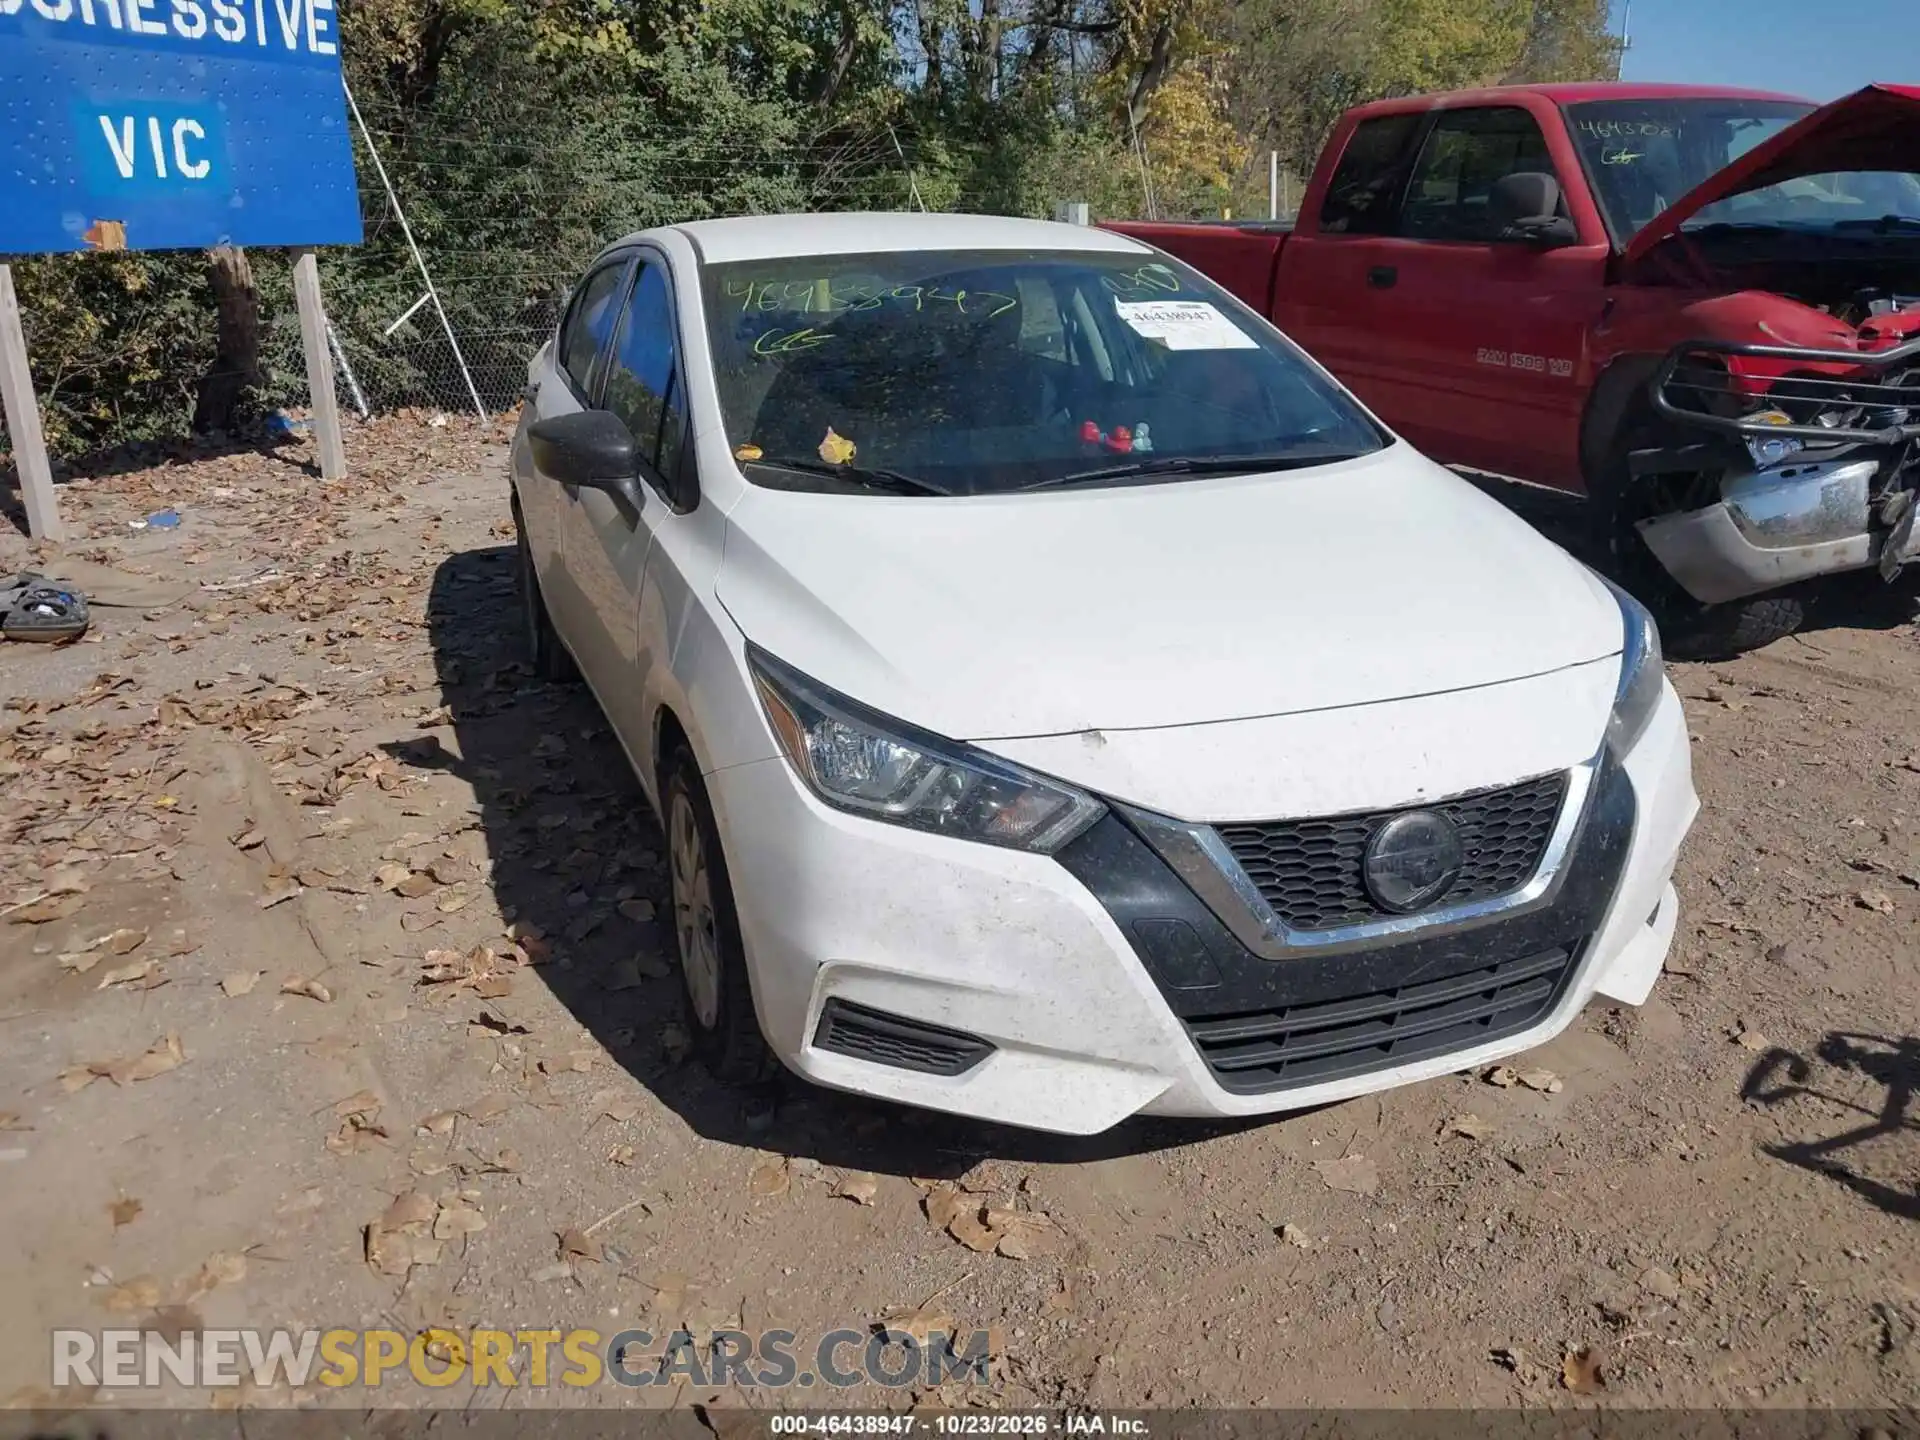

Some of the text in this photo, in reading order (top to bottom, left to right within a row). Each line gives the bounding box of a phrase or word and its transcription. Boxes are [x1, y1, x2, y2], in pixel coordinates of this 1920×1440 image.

[0, 0, 337, 54] ESSIVE
[99, 115, 210, 179] VIC
[1476, 347, 1507, 366] RAM
